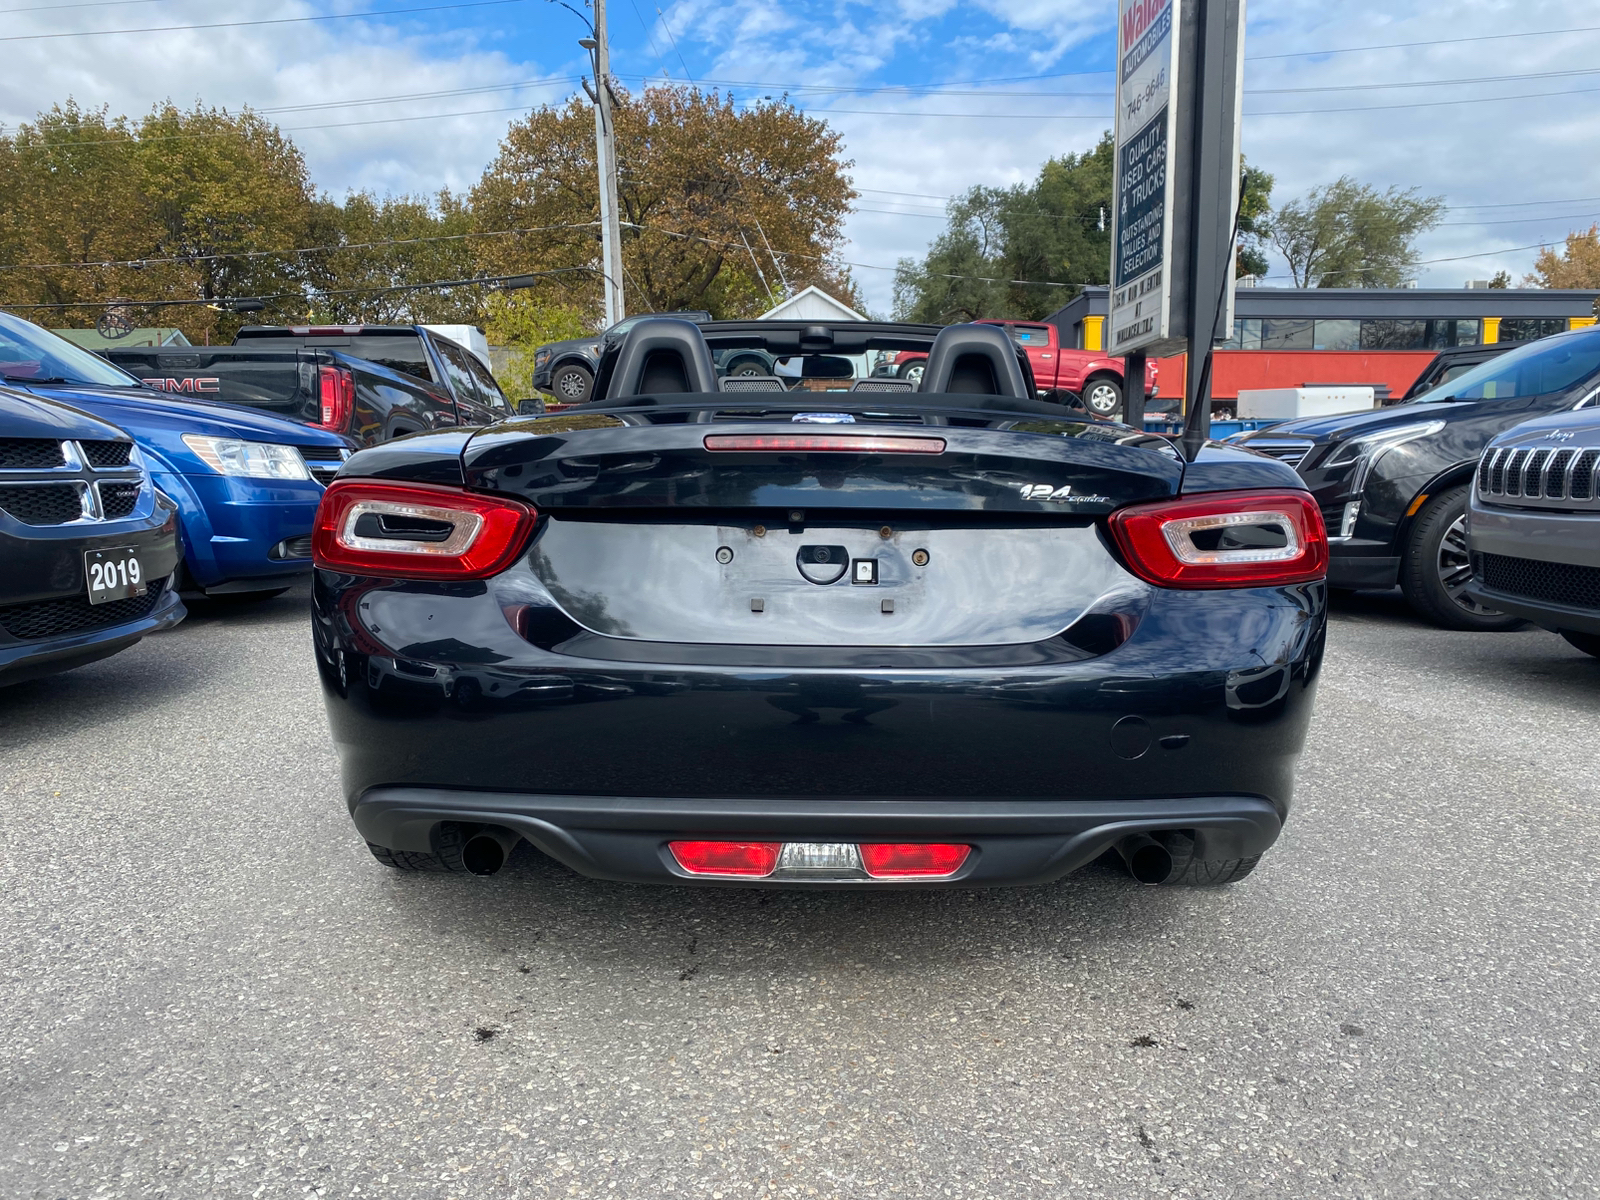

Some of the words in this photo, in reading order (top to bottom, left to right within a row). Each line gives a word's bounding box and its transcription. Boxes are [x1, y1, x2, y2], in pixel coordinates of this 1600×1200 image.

[1124, 7, 1172, 77] AUTOMOBILES
[1127, 67, 1165, 120] 746-9646
[1128, 121, 1161, 166] QUALITY
[1121, 162, 1143, 193] USED
[1146, 139, 1167, 174] CARS
[1121, 195, 1128, 215] &
[1131, 164, 1165, 208] TRUCKS
[1121, 202, 1164, 244] OUTSTANDING
[1122, 233, 1146, 259] VALUES
[1147, 222, 1161, 243] AND
[1123, 241, 1159, 276] SELECTION
[142, 377, 220, 393] GMC
[1020, 484, 1071, 502] 124
[90, 557, 140, 591] 2019
